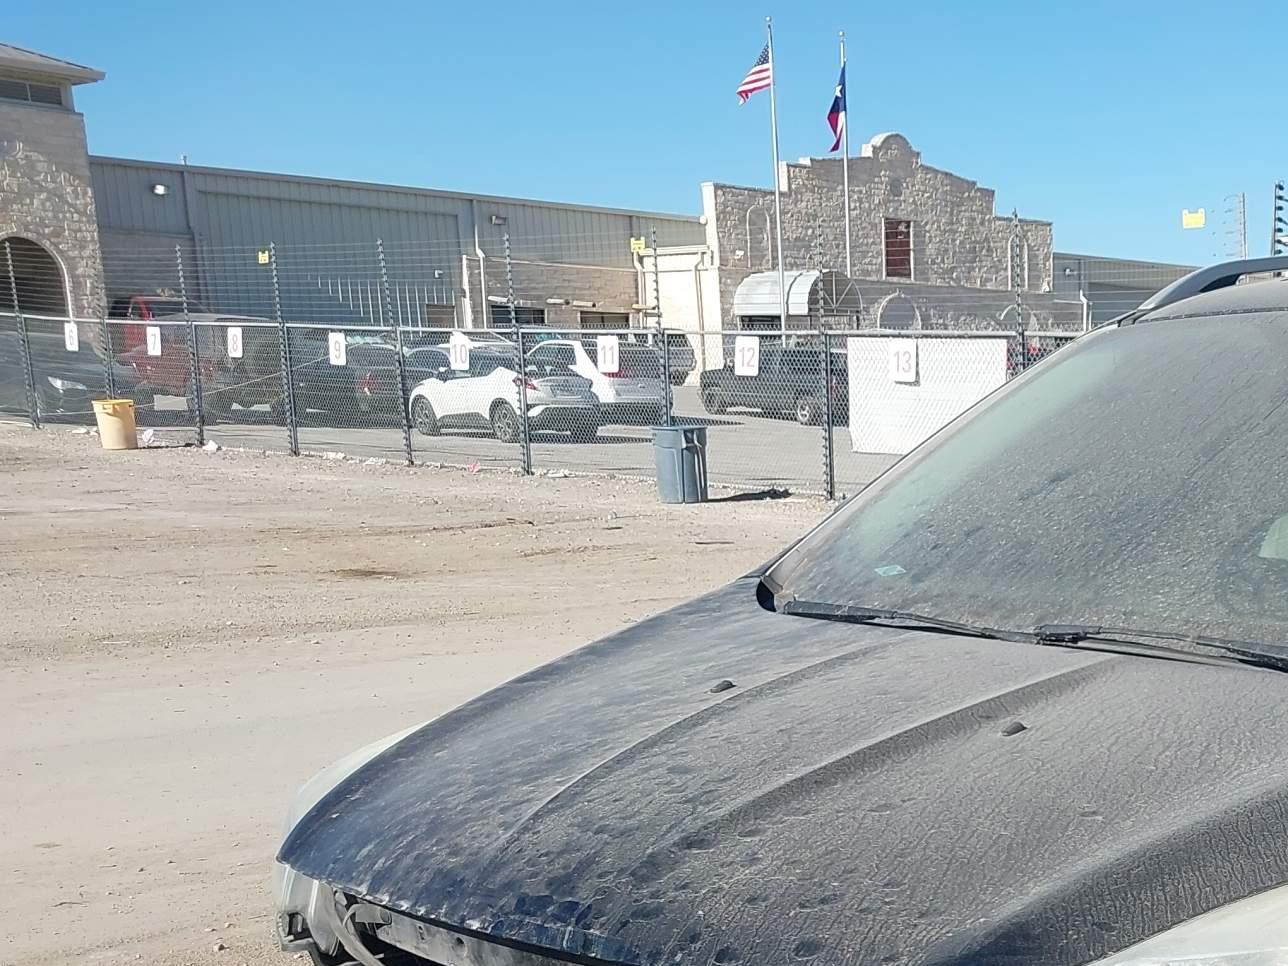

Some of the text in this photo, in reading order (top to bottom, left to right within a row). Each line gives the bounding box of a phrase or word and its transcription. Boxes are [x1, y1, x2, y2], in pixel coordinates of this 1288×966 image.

[68, 329, 75, 346] 6
[150, 333, 157, 351] 7
[231, 334, 238, 352] 8
[334, 340, 341, 359] 9
[451, 343, 467, 363] 10
[600, 345, 614, 364] 11
[739, 346, 755, 368] 12
[894, 350, 912, 373] 13
